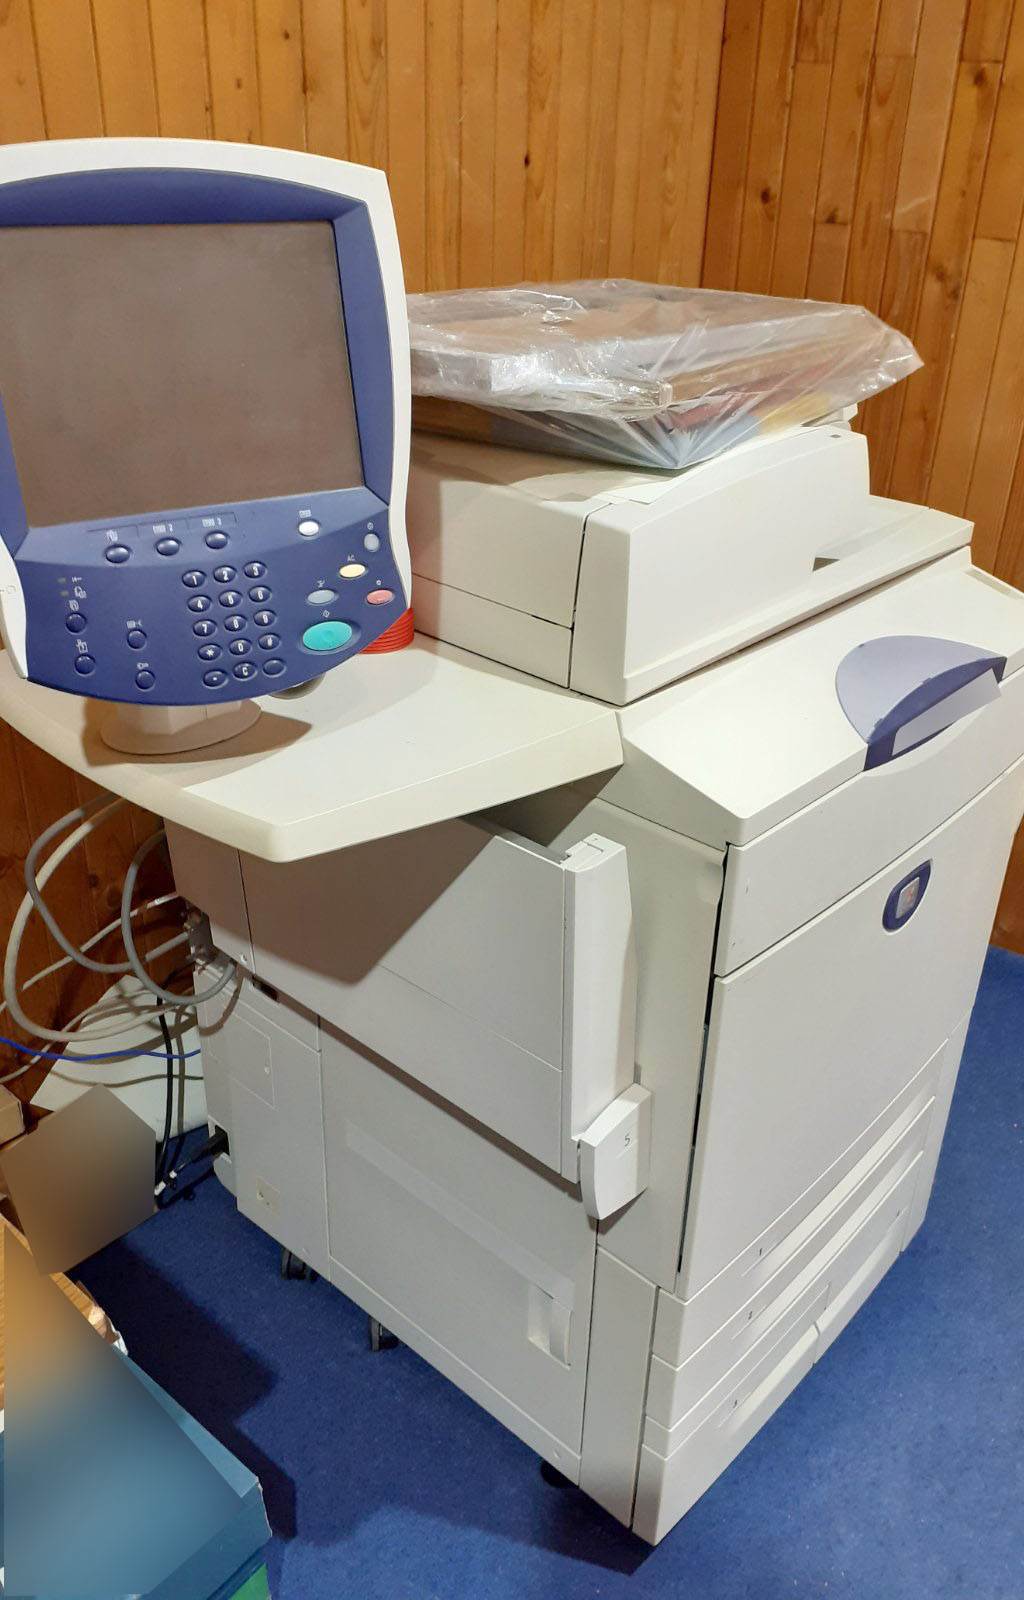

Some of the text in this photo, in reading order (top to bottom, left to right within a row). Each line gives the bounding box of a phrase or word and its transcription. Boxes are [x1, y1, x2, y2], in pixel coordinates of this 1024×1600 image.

[222, 570, 229, 581] 2
[252, 565, 259, 576] 3
[257, 590, 264, 600] 6
[237, 643, 244, 653] 0
[242, 666, 248, 676] C
[624, 1132, 631, 1147] 5
